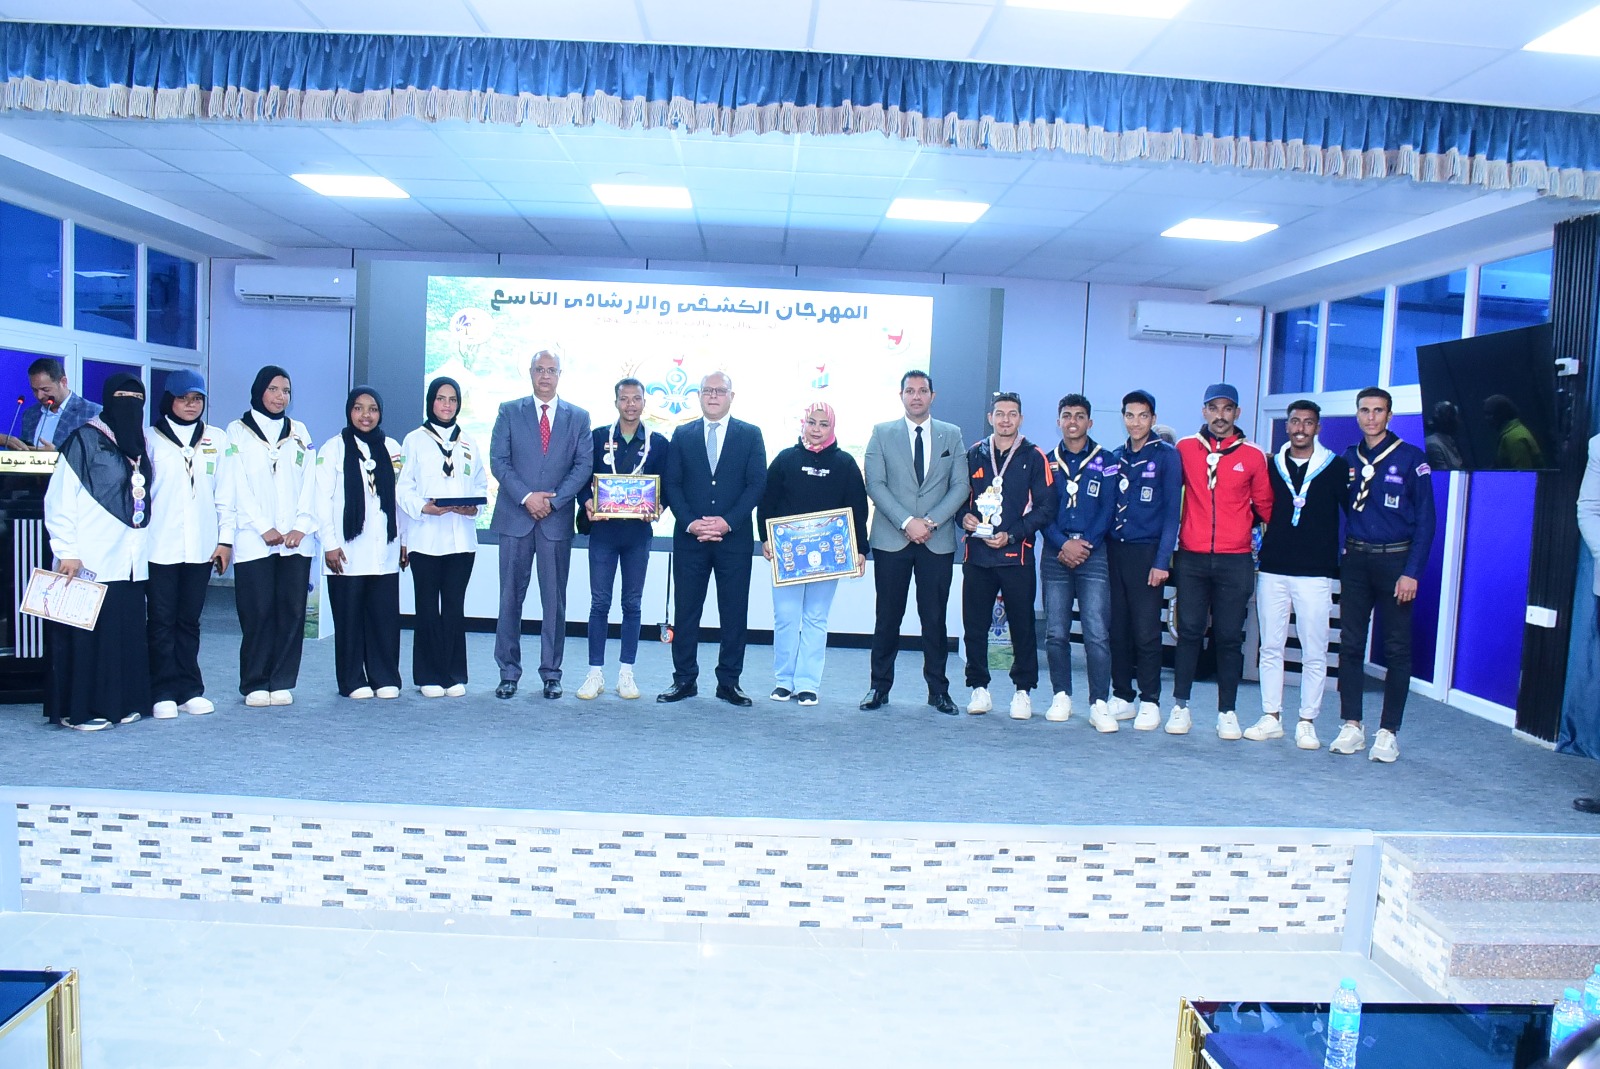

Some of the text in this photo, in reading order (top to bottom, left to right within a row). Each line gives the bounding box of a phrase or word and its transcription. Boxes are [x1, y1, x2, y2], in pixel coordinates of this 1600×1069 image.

[490, 288, 558, 312] التاسع
[776, 302, 869, 323] المهرجان
[0, 456, 27, 468] سوها
